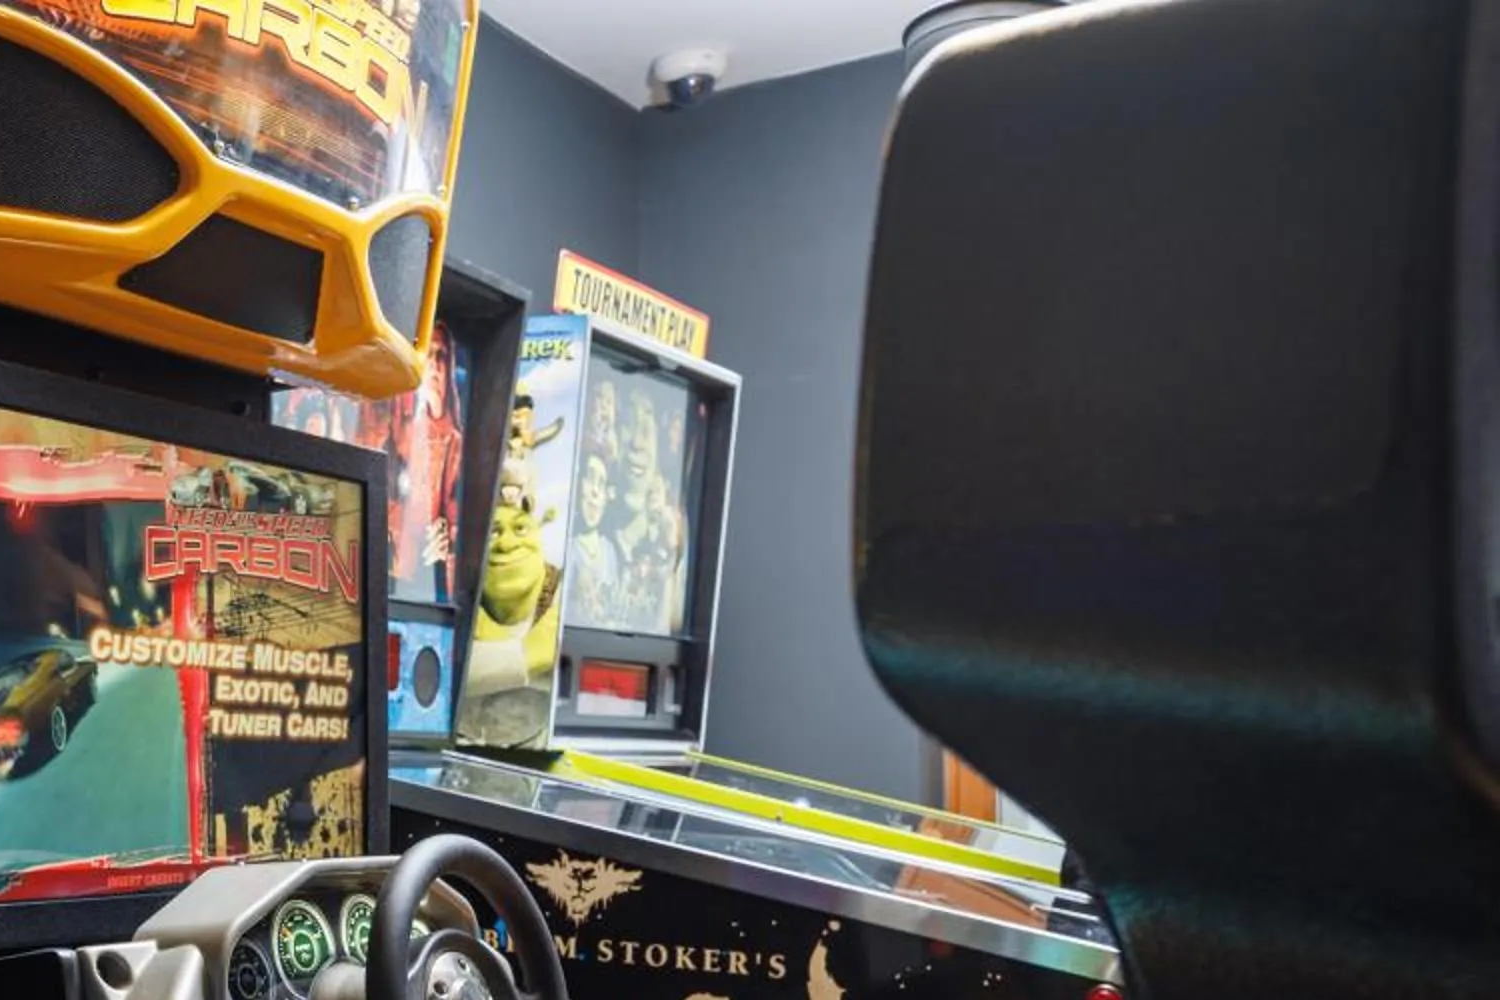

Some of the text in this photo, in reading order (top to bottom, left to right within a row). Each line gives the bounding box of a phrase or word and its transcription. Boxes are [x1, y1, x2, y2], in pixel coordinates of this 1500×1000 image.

[572, 267, 697, 353] TOURNAMENT PLAY
[171, 508, 227, 528] NEED
[255, 513, 331, 537] SPEED
[145, 524, 360, 604] CARBON
[90, 627, 354, 682] CUSTOMIZE MUSCLE,
[215, 674, 349, 708] EXOTIC, AND
[209, 708, 349, 740] TUNER CARS!
[484, 928, 787, 979] BM STOKER'S
